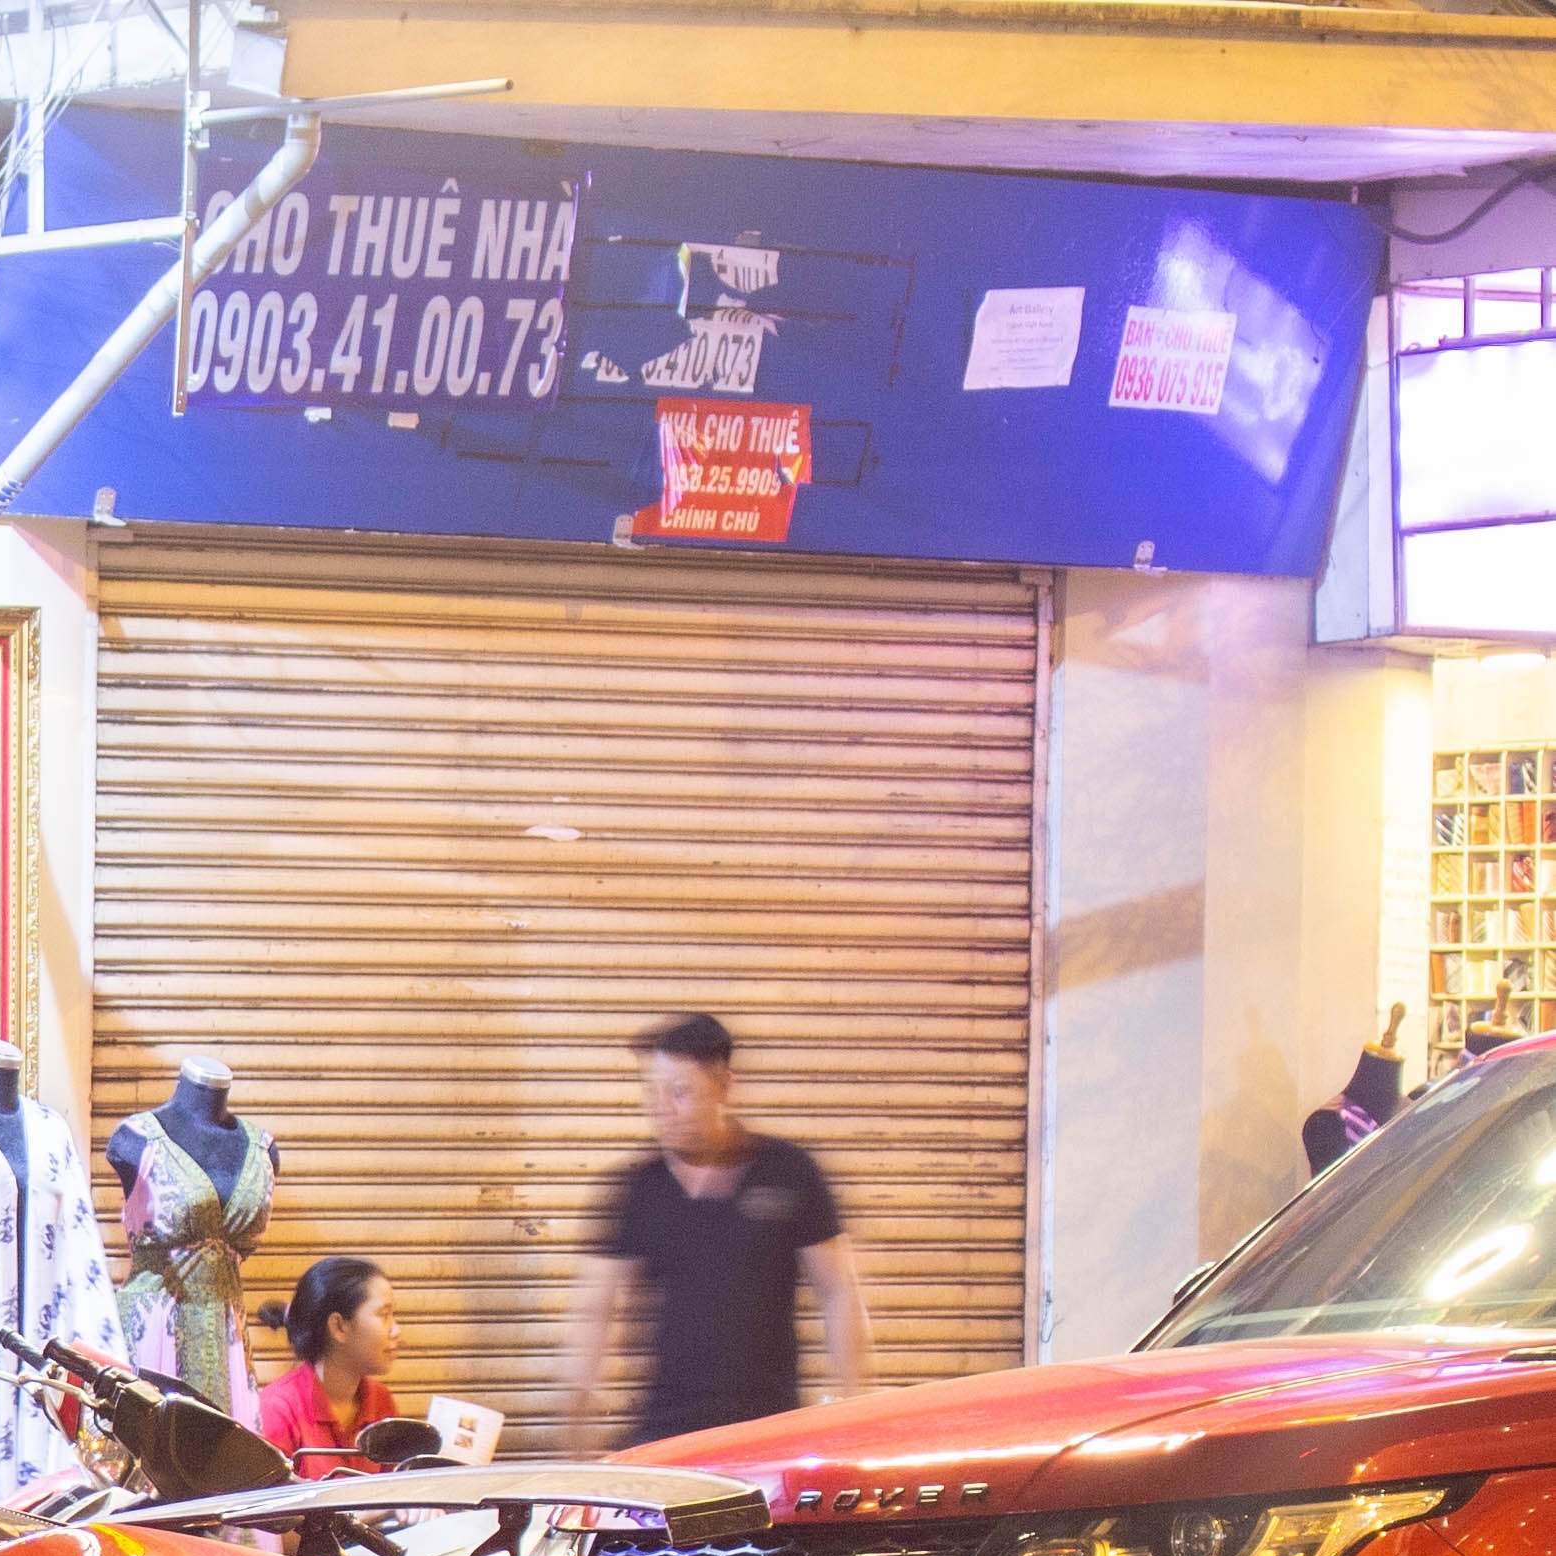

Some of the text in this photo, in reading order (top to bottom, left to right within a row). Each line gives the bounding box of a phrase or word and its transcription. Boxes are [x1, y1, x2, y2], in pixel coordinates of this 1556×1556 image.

[328, 178, 464, 279] THUÊ
[471, 181, 573, 281] NHÀ
[187, 290, 565, 398] 0903.41.00.73
[1114, 353, 1158, 402] 0936
[703, 413, 746, 452] CHO
[749, 409, 802, 455] THUÊ
[794, 1482, 989, 1513] ROVER
